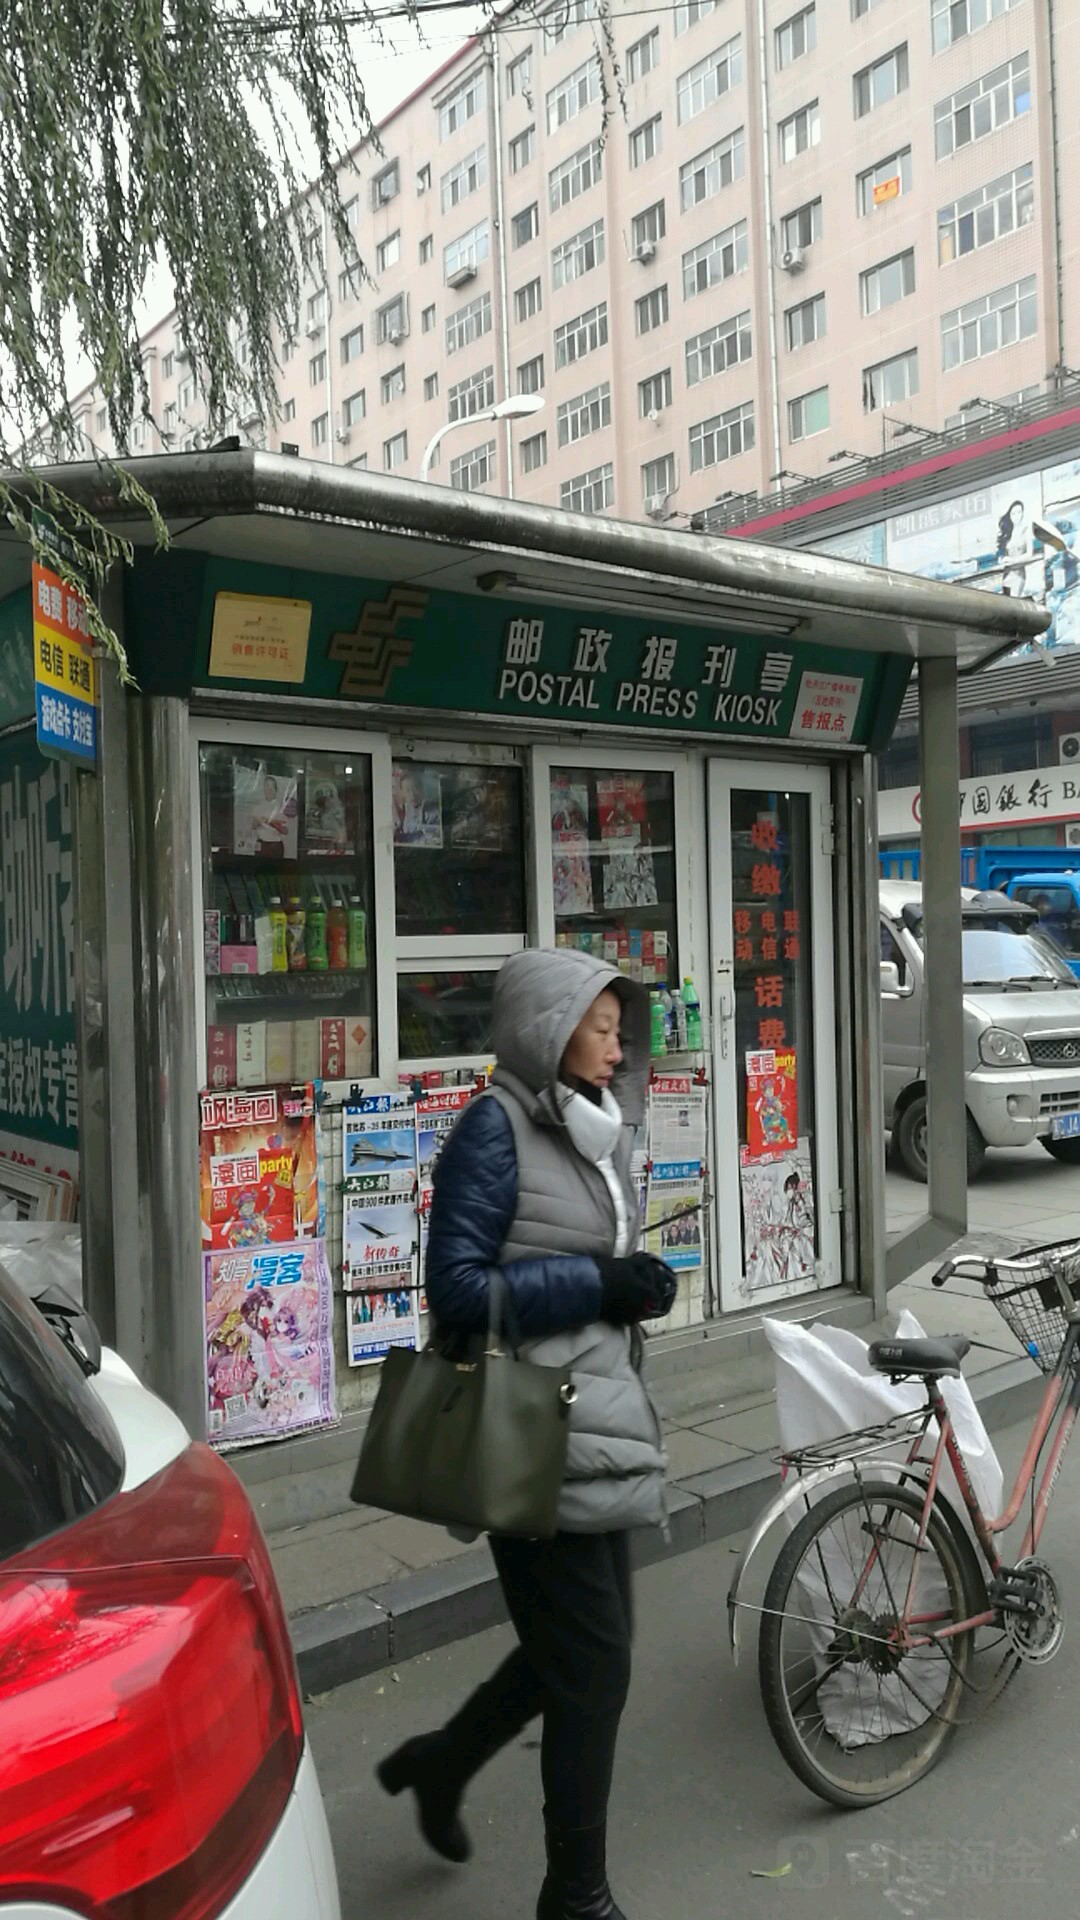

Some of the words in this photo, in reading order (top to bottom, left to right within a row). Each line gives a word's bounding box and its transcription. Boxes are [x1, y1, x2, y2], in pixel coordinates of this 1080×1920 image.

[40, 638, 64, 679] 电信
[68, 652, 91, 693] 联通
[505, 616, 794, 694] 邮政报刊亭
[499, 670, 600, 711] POSTAL
[616, 682, 698, 719] PRESS
[713, 694, 782, 727] KIOSK
[801, 709, 847, 732] 售报点
[260, 1155, 292, 1178] party
[246, 1252, 305, 1290] 漫客
